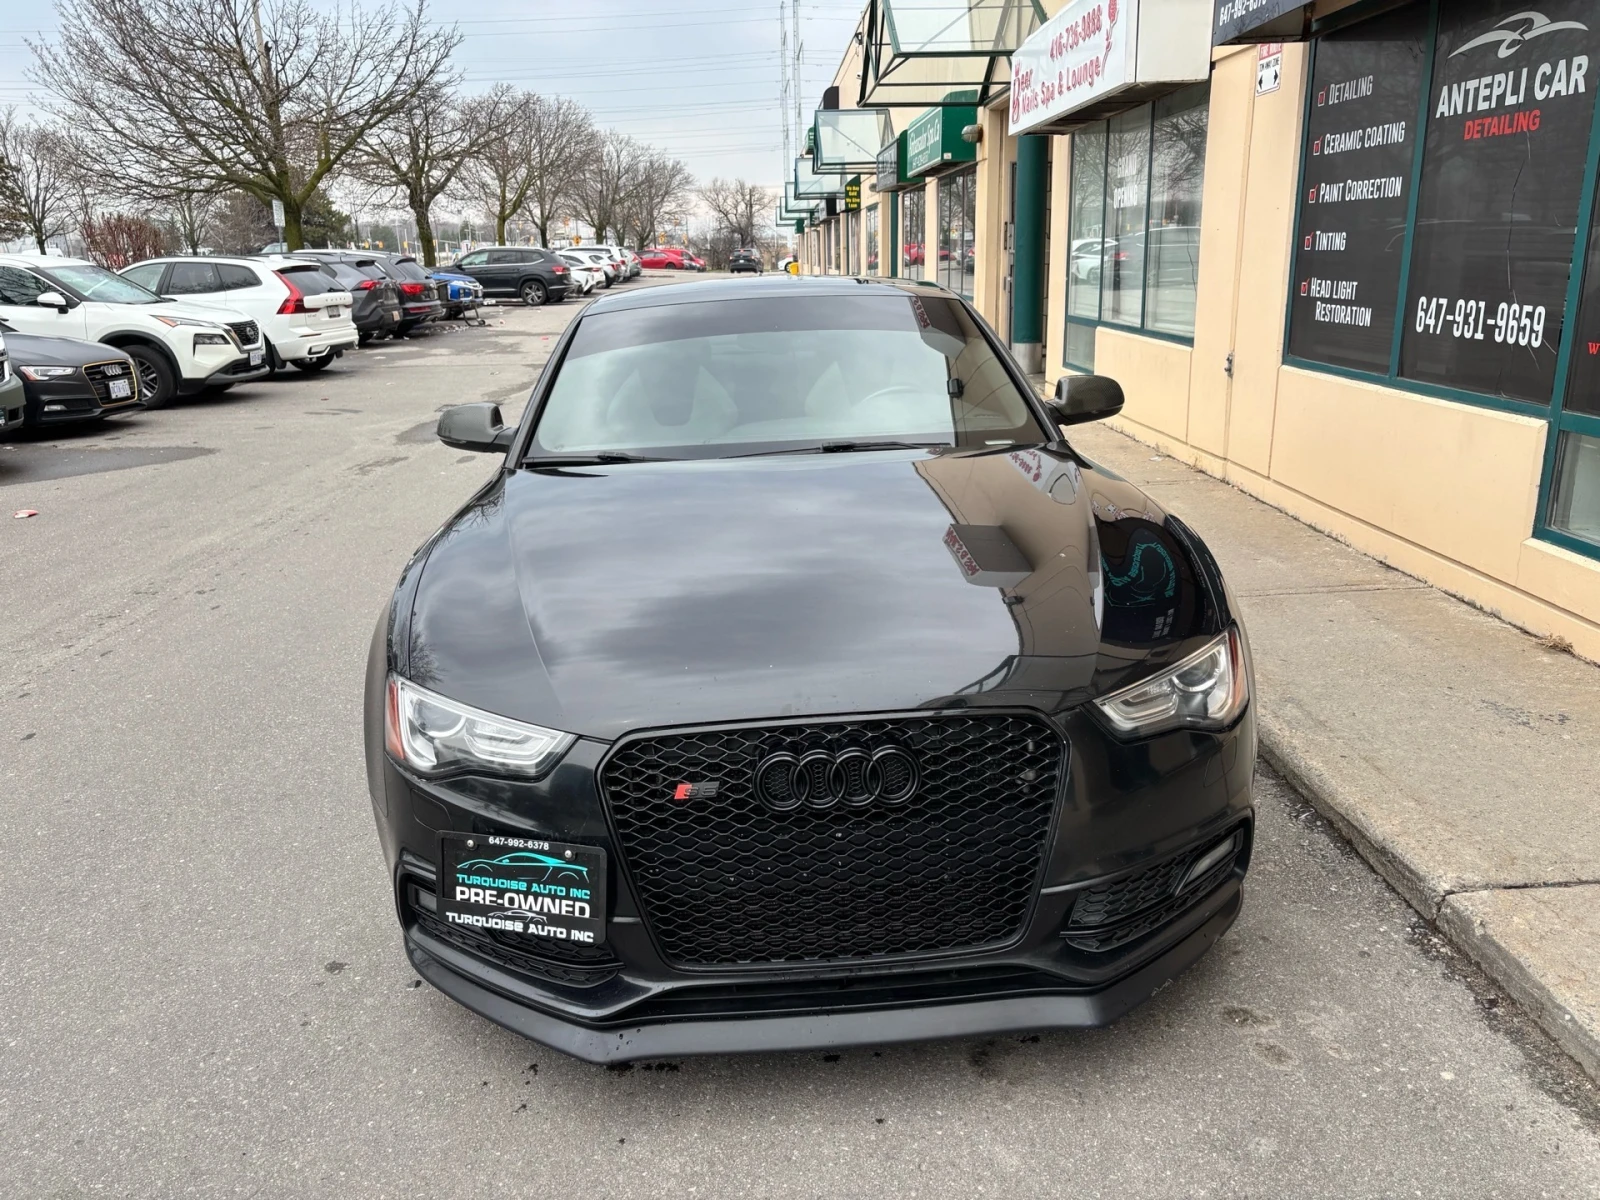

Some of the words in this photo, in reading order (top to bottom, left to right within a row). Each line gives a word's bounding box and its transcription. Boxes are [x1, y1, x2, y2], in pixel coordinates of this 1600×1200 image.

[1050, 4, 1102, 62] 416-736-9888
[1021, 88, 1039, 115] Nails
[1041, 81, 1055, 109] Spa
[1057, 71, 1063, 96] &
[1066, 56, 1101, 91] Lounge
[1435, 67, 1528, 118] ANTEPLI
[1533, 55, 1589, 101] CAR
[1464, 109, 1540, 140] DETAILING
[1117, 153, 1137, 178] GRAND
[1113, 184, 1138, 209] OPENING
[1415, 296, 1546, 348] 647-931-9659
[488, 836, 549, 850] 647-992-6378
[456, 873, 527, 891] TURQUOISE
[531, 881, 566, 896] AUTO
[570, 887, 591, 899] INC
[455, 886, 591, 919] PRE-OWNED
[445, 911, 524, 932] TURQUOISE
[528, 923, 567, 938] AUTO
[571, 929, 594, 942] INC
